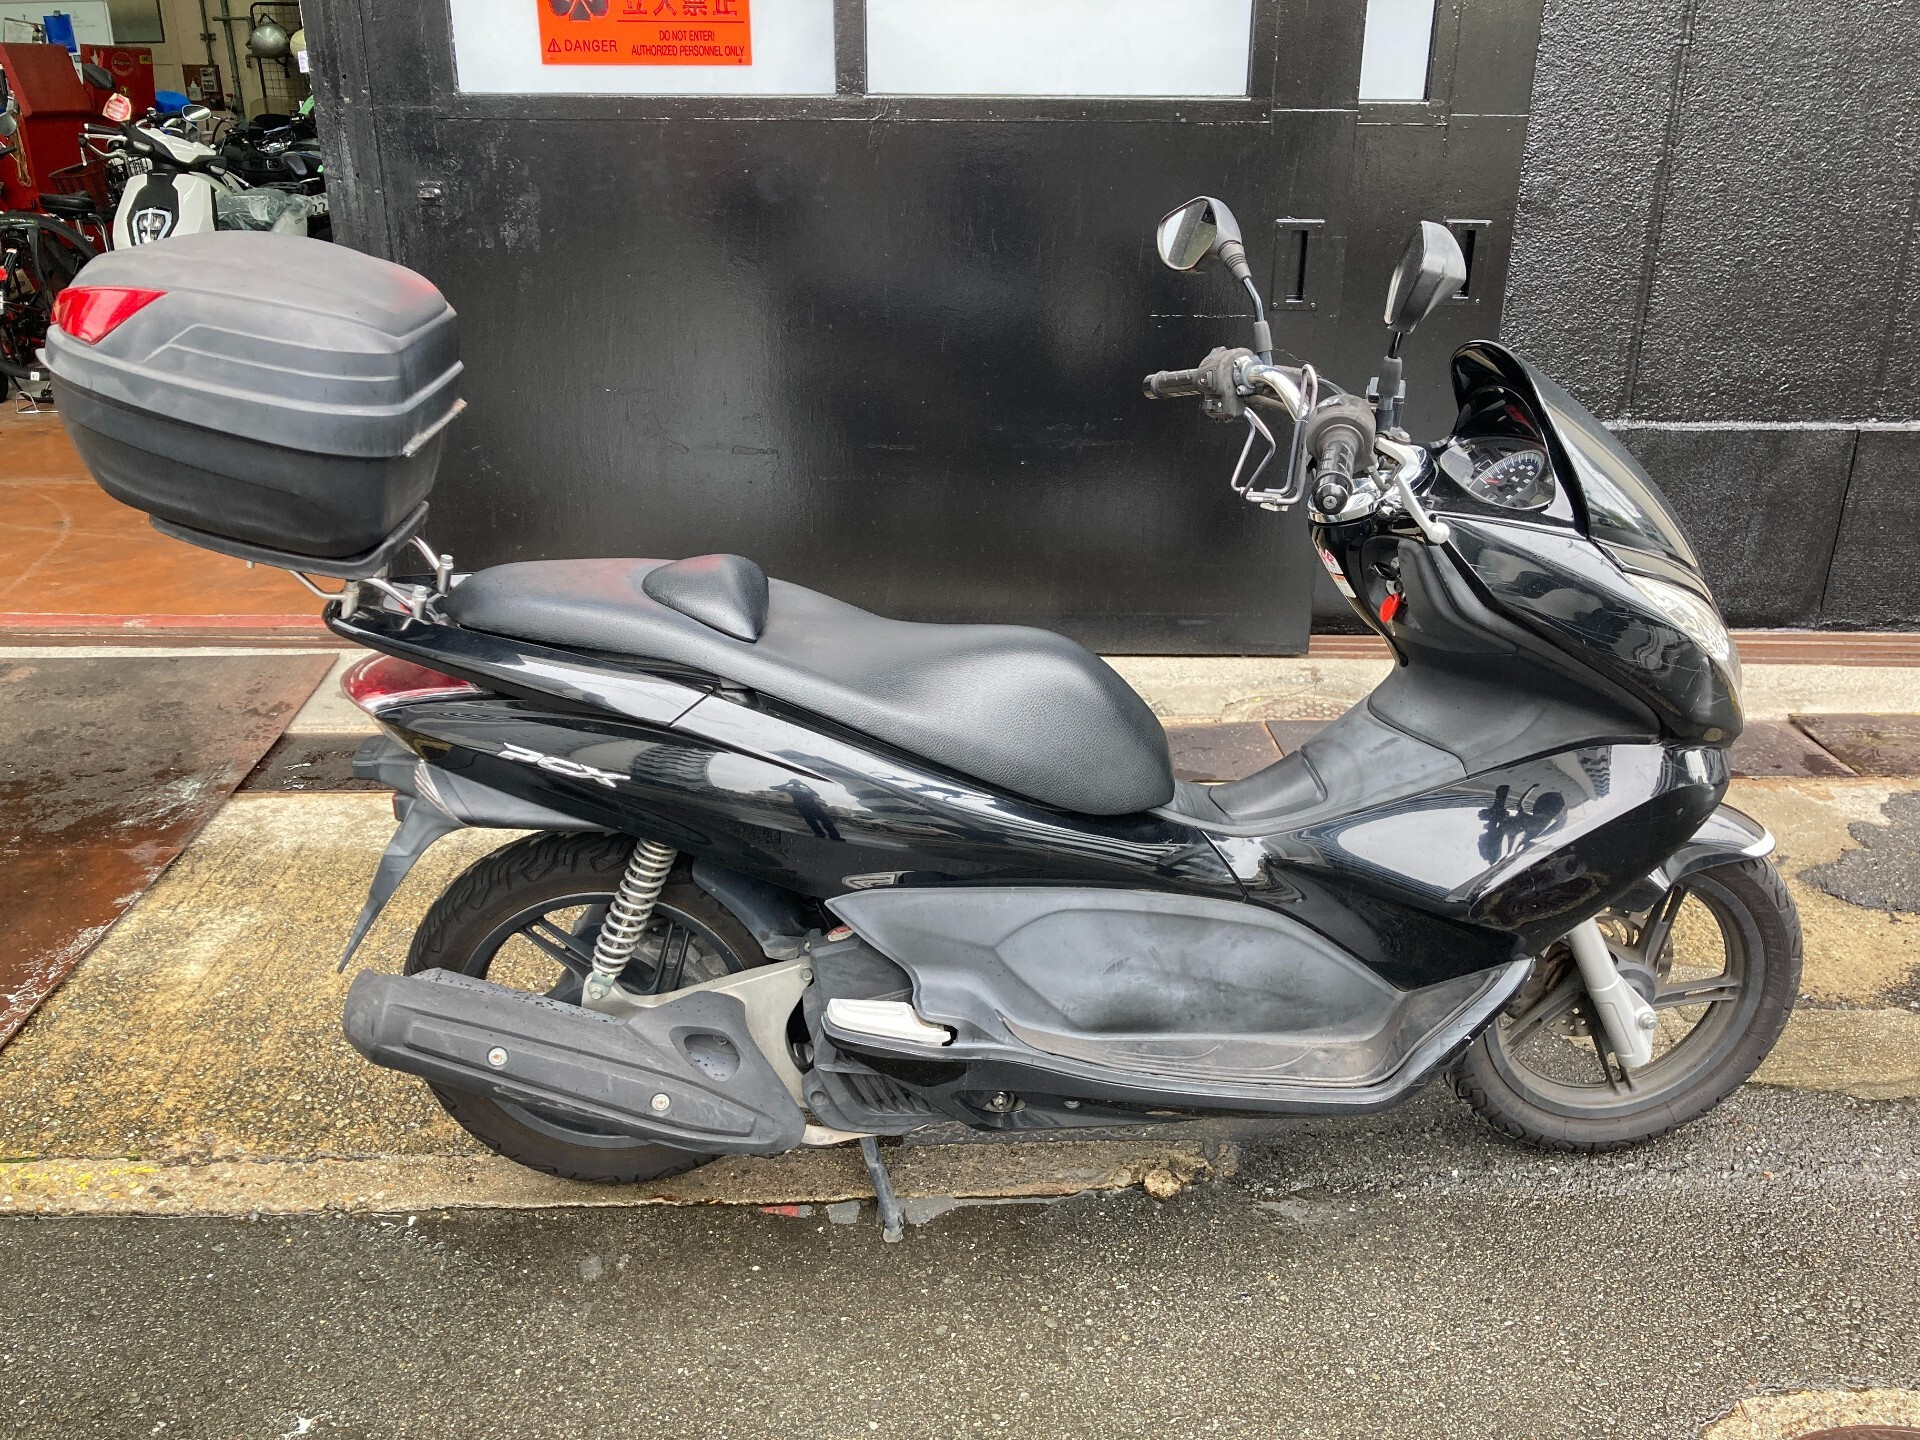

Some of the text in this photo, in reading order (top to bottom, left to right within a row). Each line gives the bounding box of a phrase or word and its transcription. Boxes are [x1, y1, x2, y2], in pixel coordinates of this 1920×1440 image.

[659, 30, 715, 41] DO NOT ENTER!
[564, 39, 618, 53] DANGER
[632, 45, 745, 57] AUTHORIZED PERSONNEL ONLY
[498, 742, 631, 788] PCX
